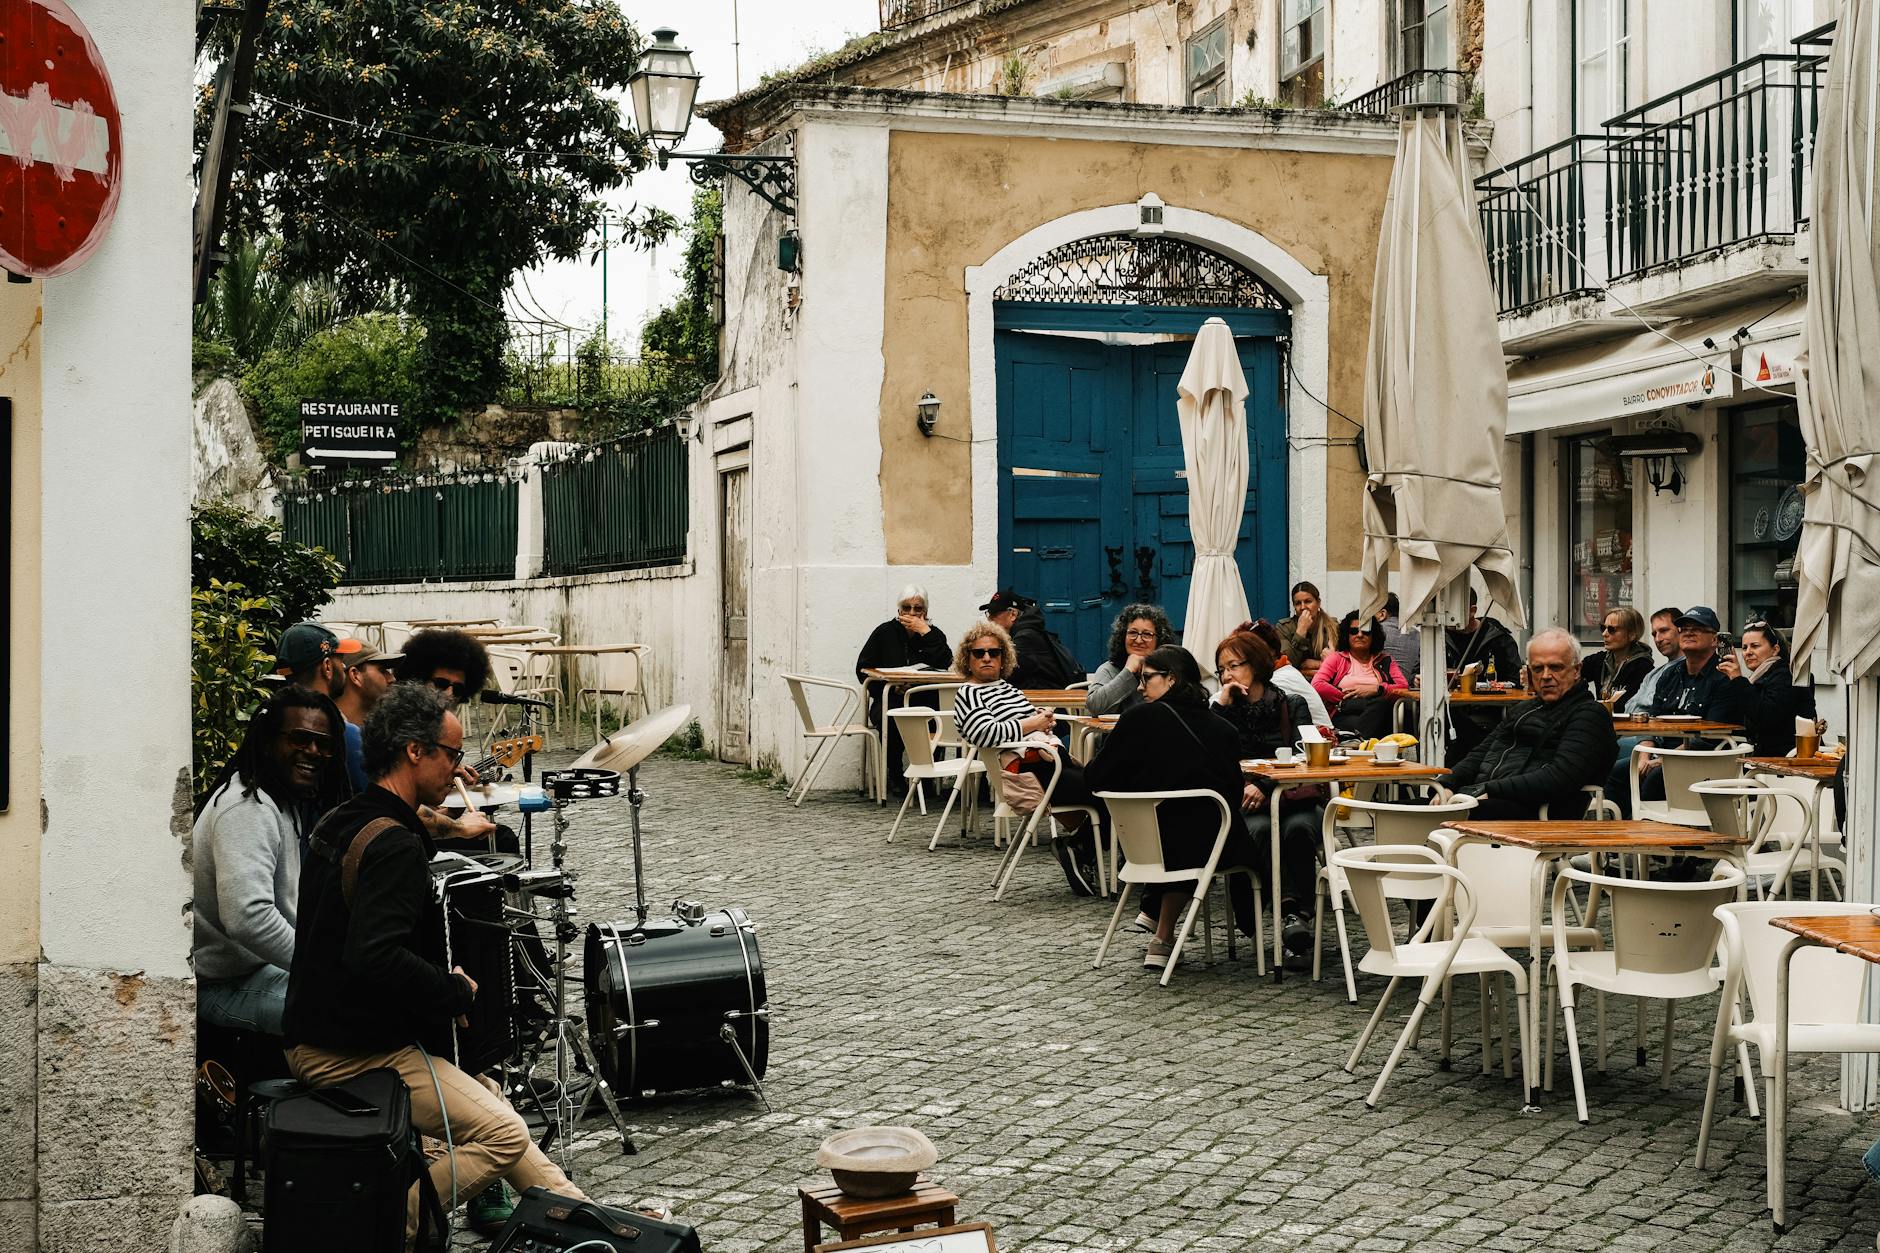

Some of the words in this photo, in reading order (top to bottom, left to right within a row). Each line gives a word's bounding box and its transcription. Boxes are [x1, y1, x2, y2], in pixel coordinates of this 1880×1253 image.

[1623, 394, 1646, 406] BAIRRO
[301, 403, 399, 416] RESTAURANTE
[305, 425, 396, 438] PETISQUEIRA
